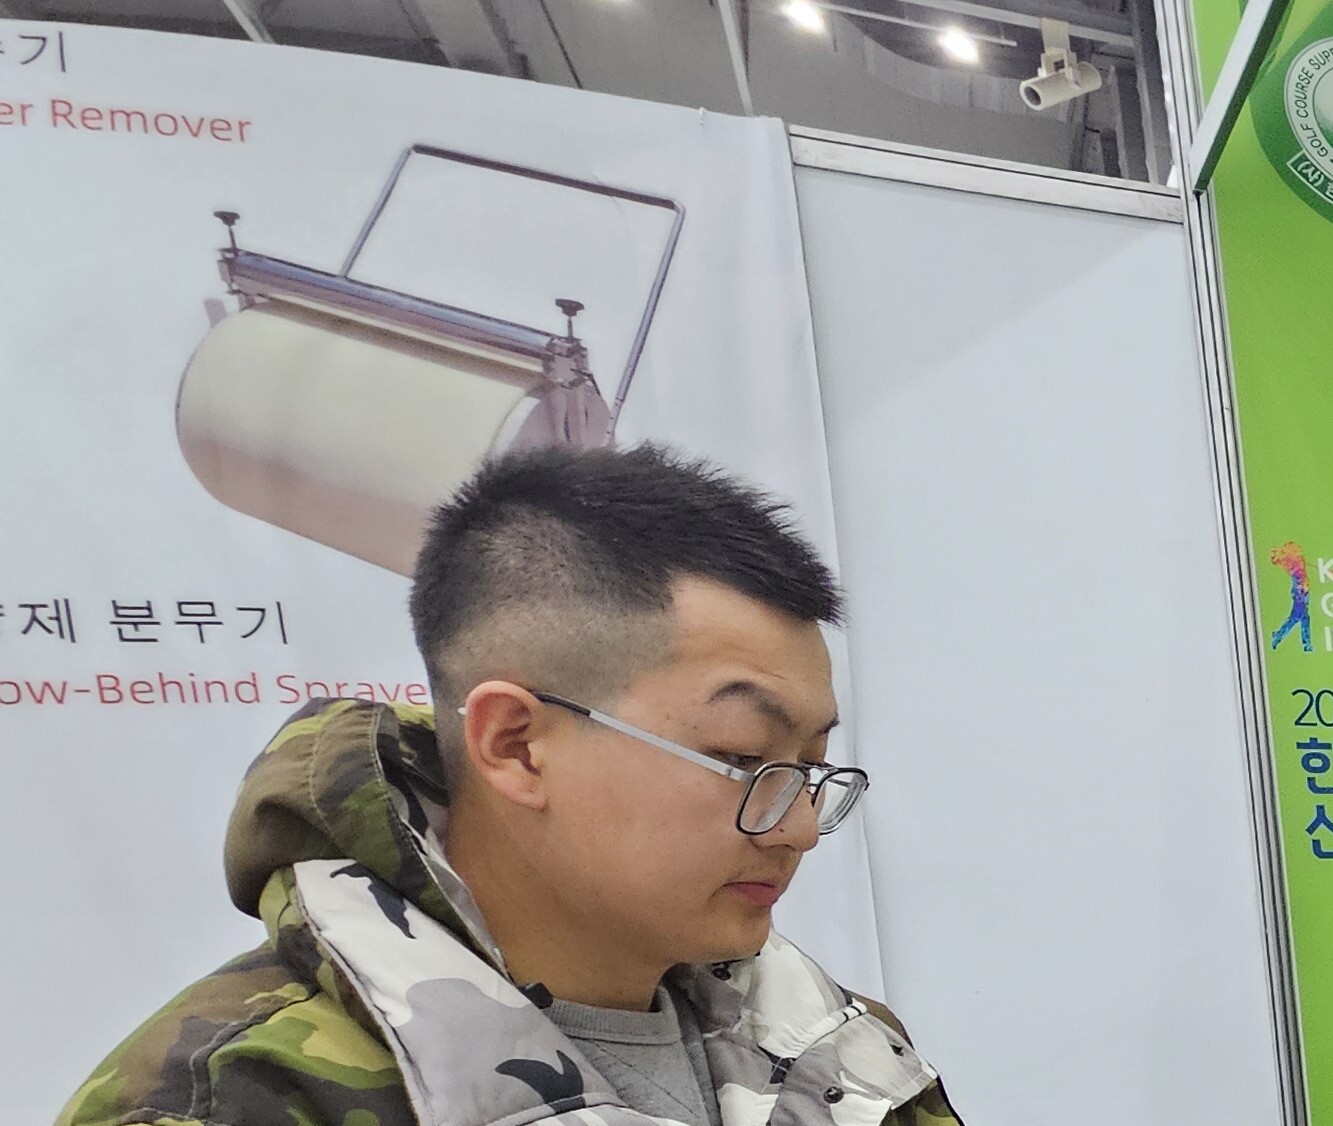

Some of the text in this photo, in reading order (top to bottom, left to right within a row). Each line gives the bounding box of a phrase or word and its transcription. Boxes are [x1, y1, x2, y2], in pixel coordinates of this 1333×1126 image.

[0, 31, 66, 73] 기
[1294, 67, 1315, 118] COURSE
[51, 99, 252, 143] Remover
[1300, 122, 1329, 158] GOLF
[1297, 160, 1325, 187] (사)
[0, 598, 289, 645] 제 분무기
